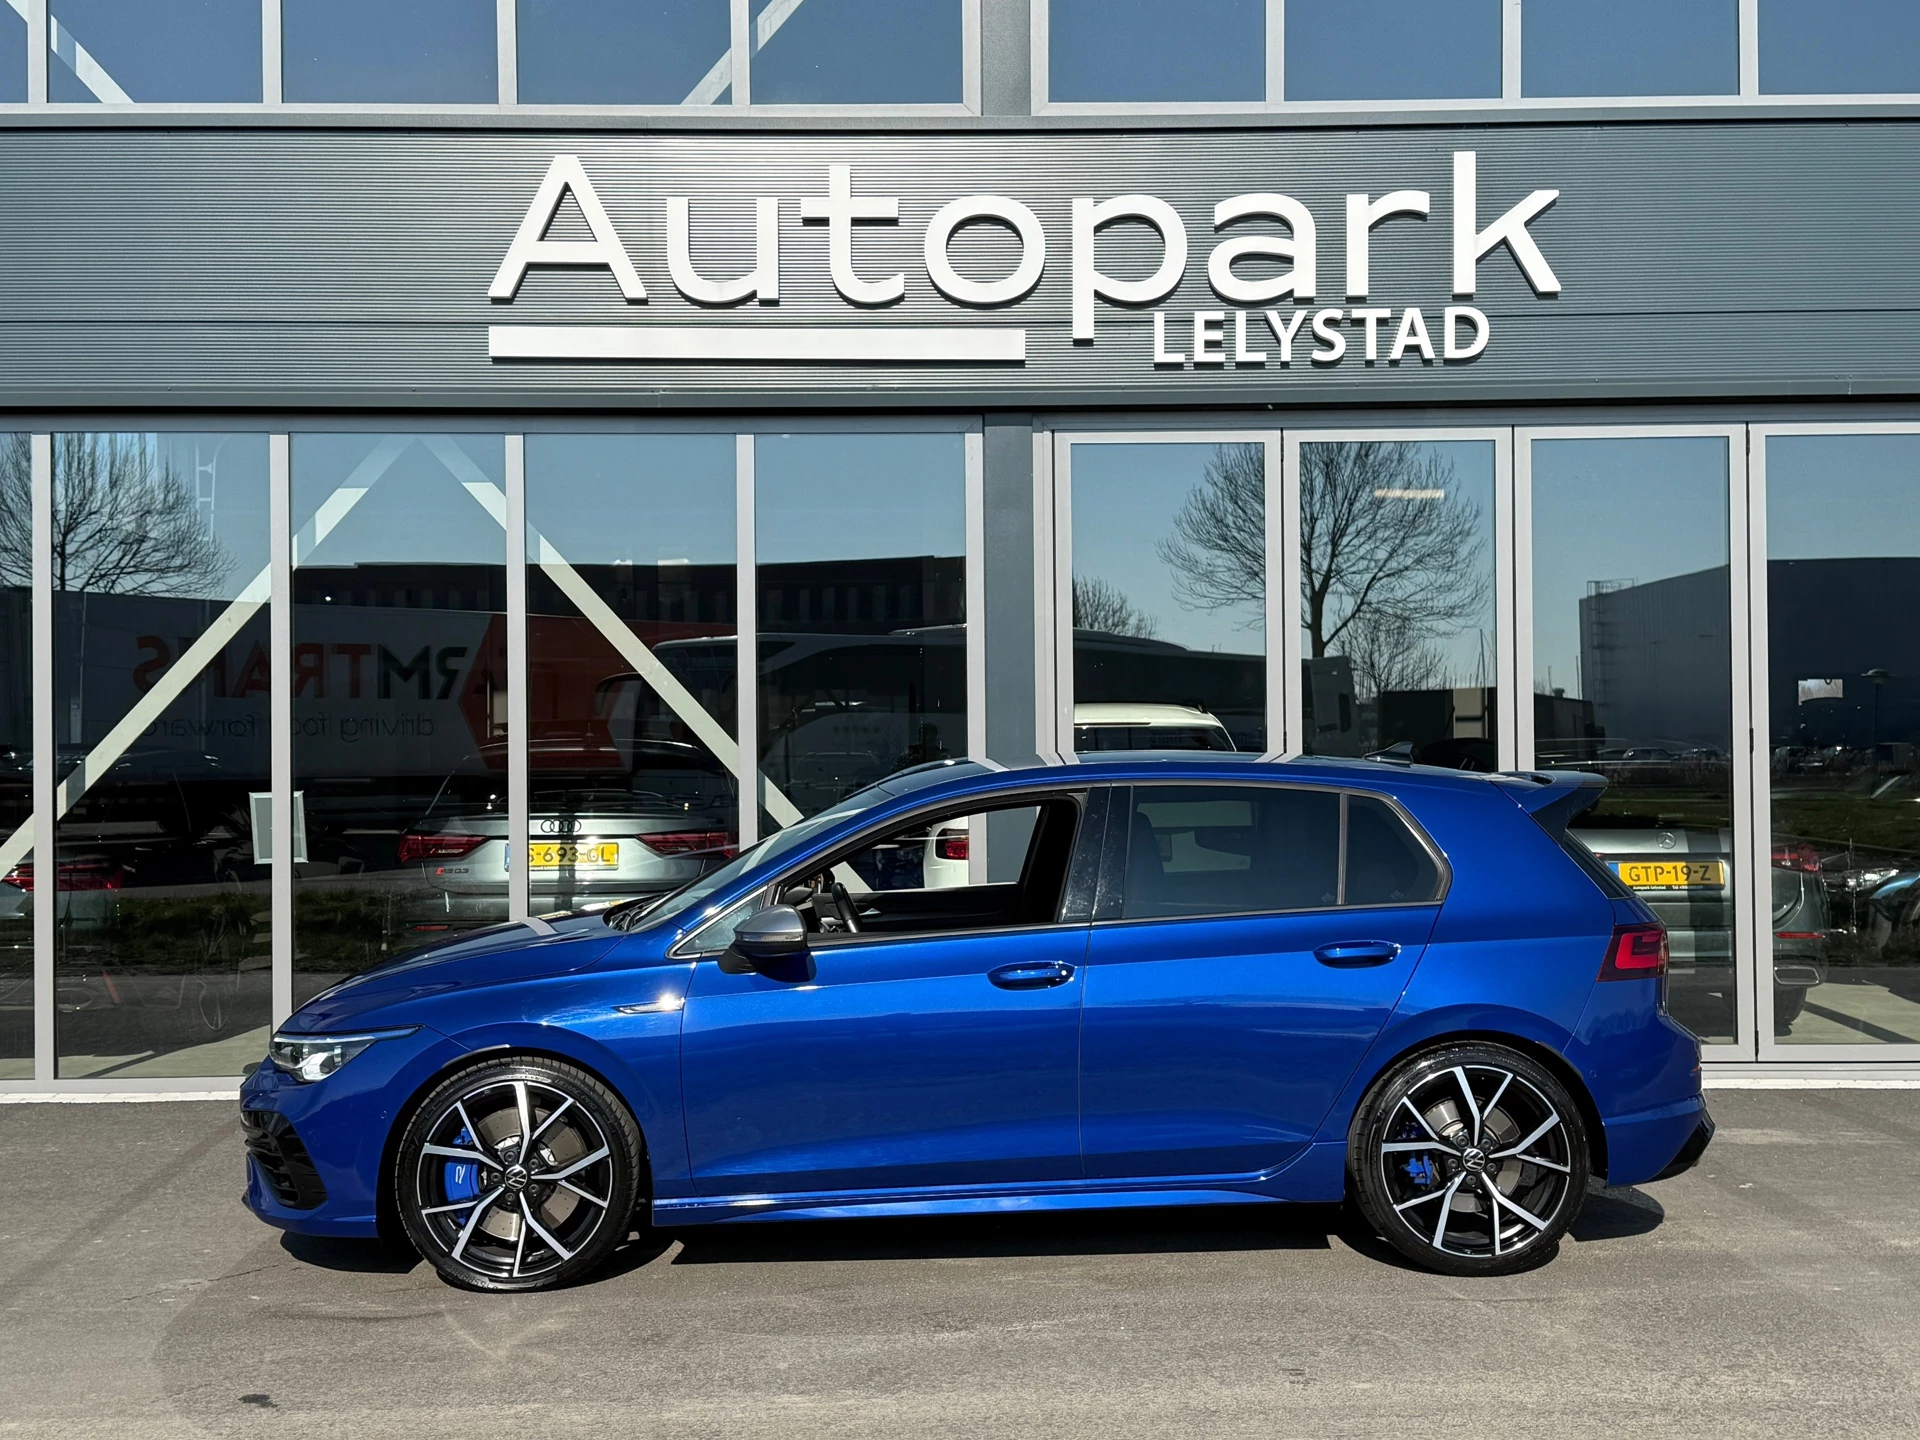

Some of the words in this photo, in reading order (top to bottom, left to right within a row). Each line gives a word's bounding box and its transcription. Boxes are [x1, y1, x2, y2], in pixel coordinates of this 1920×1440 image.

[488, 153, 1562, 341] Autopark
[1153, 308, 1490, 369] LELYSTAD
[1628, 864, 1712, 883] GTP-19-Z
